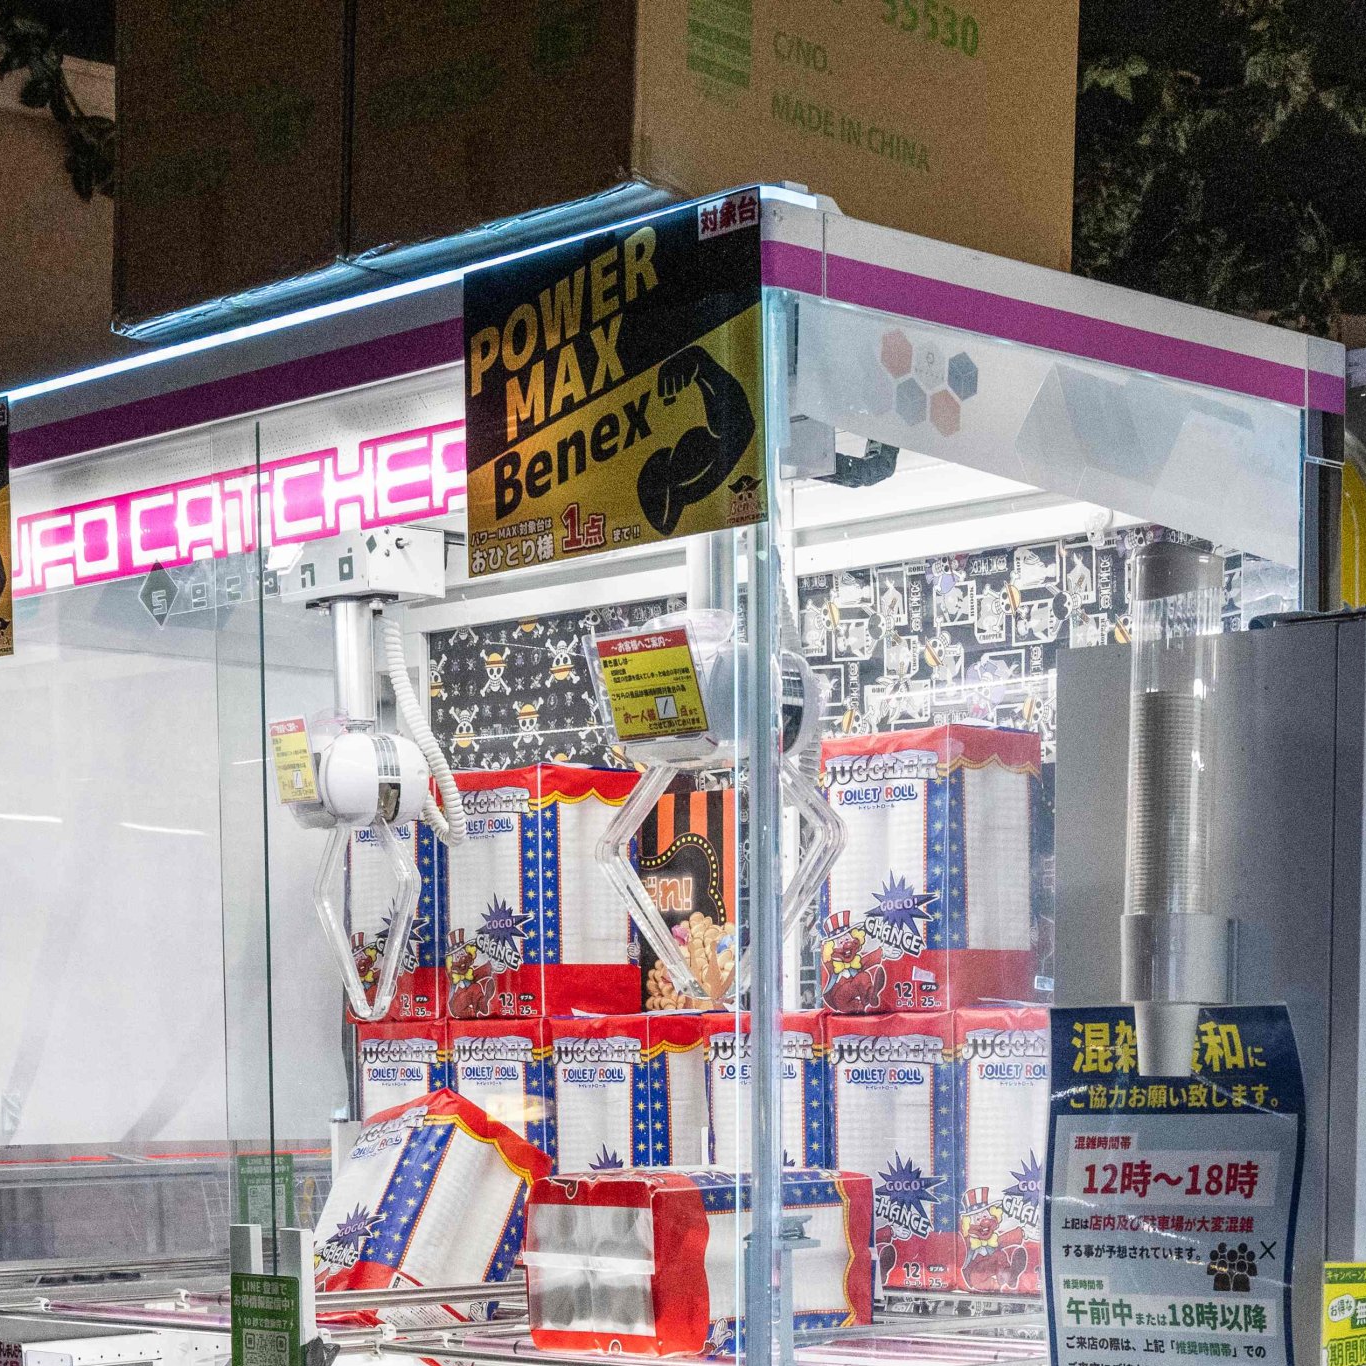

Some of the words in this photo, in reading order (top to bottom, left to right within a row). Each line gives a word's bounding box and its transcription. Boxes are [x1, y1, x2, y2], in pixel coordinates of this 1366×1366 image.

[771, 92, 835, 138] MADE
[840, 116, 862, 146] IN
[867, 126, 931, 173] CHINA
[700, 199, 759, 234] 対象台
[470, 226, 660, 398] POWER
[507, 312, 626, 442] MAX
[494, 389, 653, 521] Benex
[471, 536, 555, 577] おひとり様
[561, 502, 607, 554] 1点
[823, 751, 939, 788] JUGGLER
[461, 788, 530, 815] GGLER
[837, 785, 881, 806] TOILET
[885, 783, 918, 801] ROLL
[487, 816, 514, 833] ROLL
[880, 897, 919, 912] GOGO!
[485, 916, 517, 931] GOGO!
[865, 916, 927, 956] CHANCE
[476, 933, 522, 971] CHANCE
[499, 993, 514, 1008] 12
[894, 983, 914, 998] 12
[361, 1036, 439, 1064] JUGGLER
[453, 1036, 534, 1064] JUGGLER
[553, 1036, 642, 1065] JUGGLER
[831, 1033, 944, 1066] JUGGLER
[367, 1065, 398, 1081] TOILET
[400, 1066, 423, 1081] ROLL
[461, 1065, 493, 1081] TOILET
[494, 1065, 519, 1080] ROLL
[562, 1066, 595, 1082] TOILET
[597, 1066, 625, 1081] ROLL
[844, 1067, 888, 1084] TOILET
[888, 1067, 924, 1084] ROLL
[978, 1063, 1022, 1080] TOILET
[1070, 1083, 1279, 1110] ご協力お願い致します。
[1074, 1135, 1132, 1151] 混雑時間帯
[885, 1179, 926, 1193] GOGO!
[1061, 1213, 1254, 1234] 上記は店内及び駐車場が大変混雑
[1061, 1243, 1202, 1262] する事が予想されています。
[903, 1263, 920, 1279] 12
[1063, 1278, 1105, 1291] 推奨時間帯
[1065, 1296, 1268, 1334] 午前中または18時以降
[1329, 1298, 1355, 1318] お得な
[1065, 1334, 1267, 1359] ご来店の際は、上記「推奨時間帯」での
